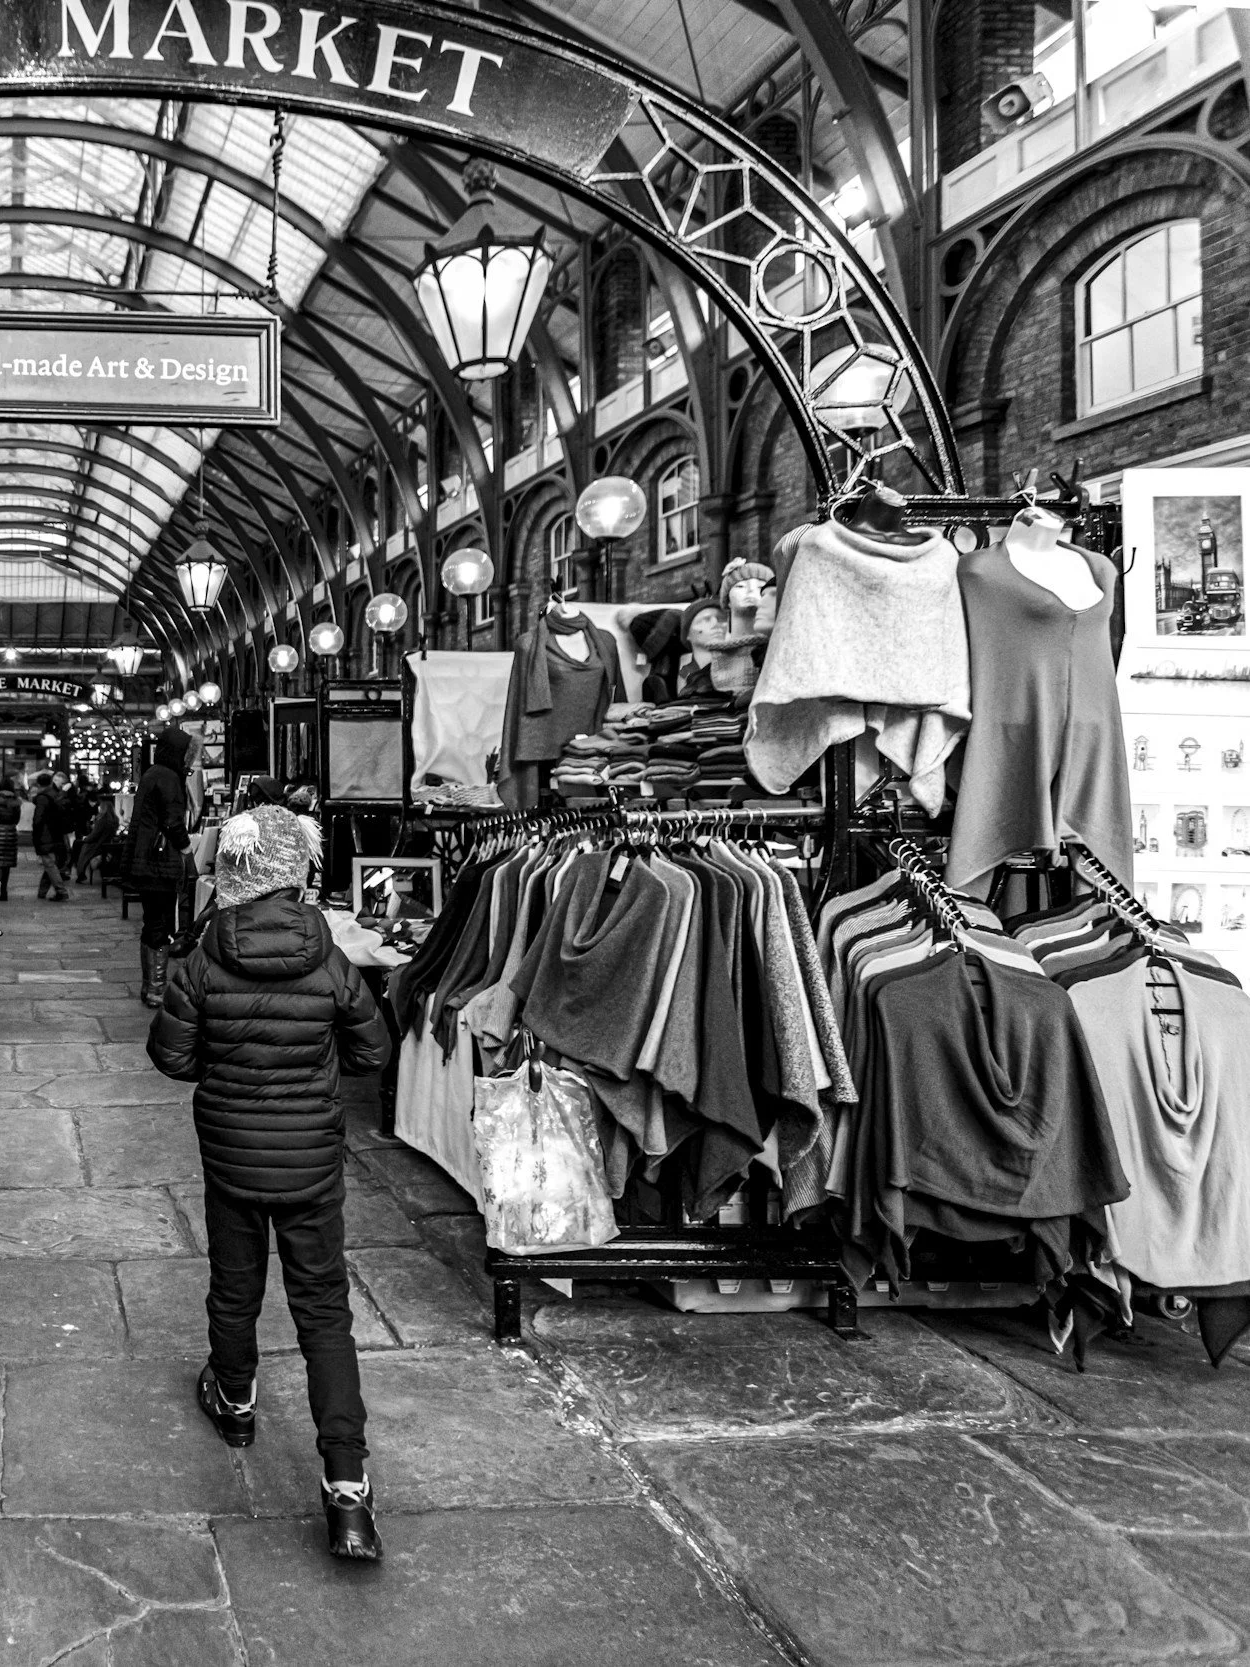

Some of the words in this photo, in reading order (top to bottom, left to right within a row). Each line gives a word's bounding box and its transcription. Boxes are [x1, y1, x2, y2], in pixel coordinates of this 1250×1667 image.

[56, 0, 504, 117] MARKET
[87, 356, 129, 379] Art
[134, 357, 155, 380] &
[160, 358, 249, 386] Design
[17, 677, 83, 697] MARKET
